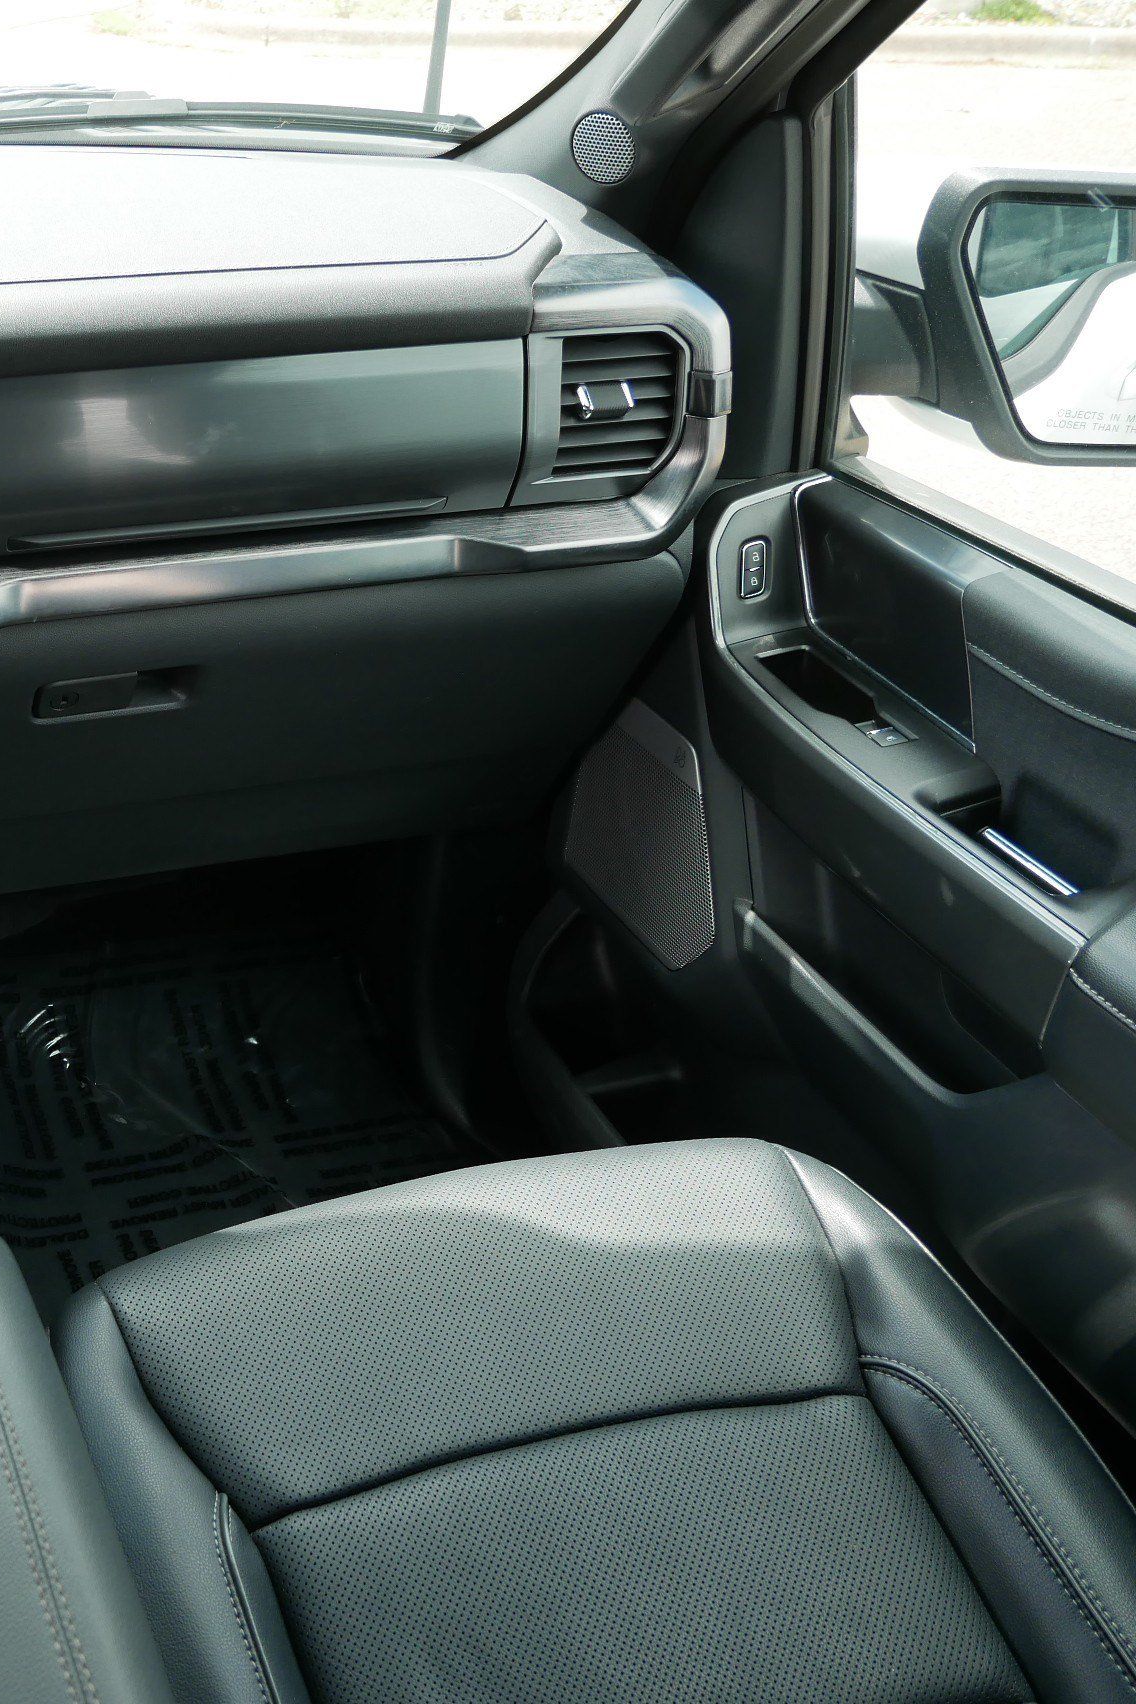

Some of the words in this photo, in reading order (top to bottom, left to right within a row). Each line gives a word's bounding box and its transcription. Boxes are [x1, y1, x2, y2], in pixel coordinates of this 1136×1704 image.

[1057, 408, 1104, 422] OBJECTS
[1110, 413, 1121, 422] IN
[1047, 418, 1086, 431] CLOSER
[1092, 422, 1120, 433] THAN
